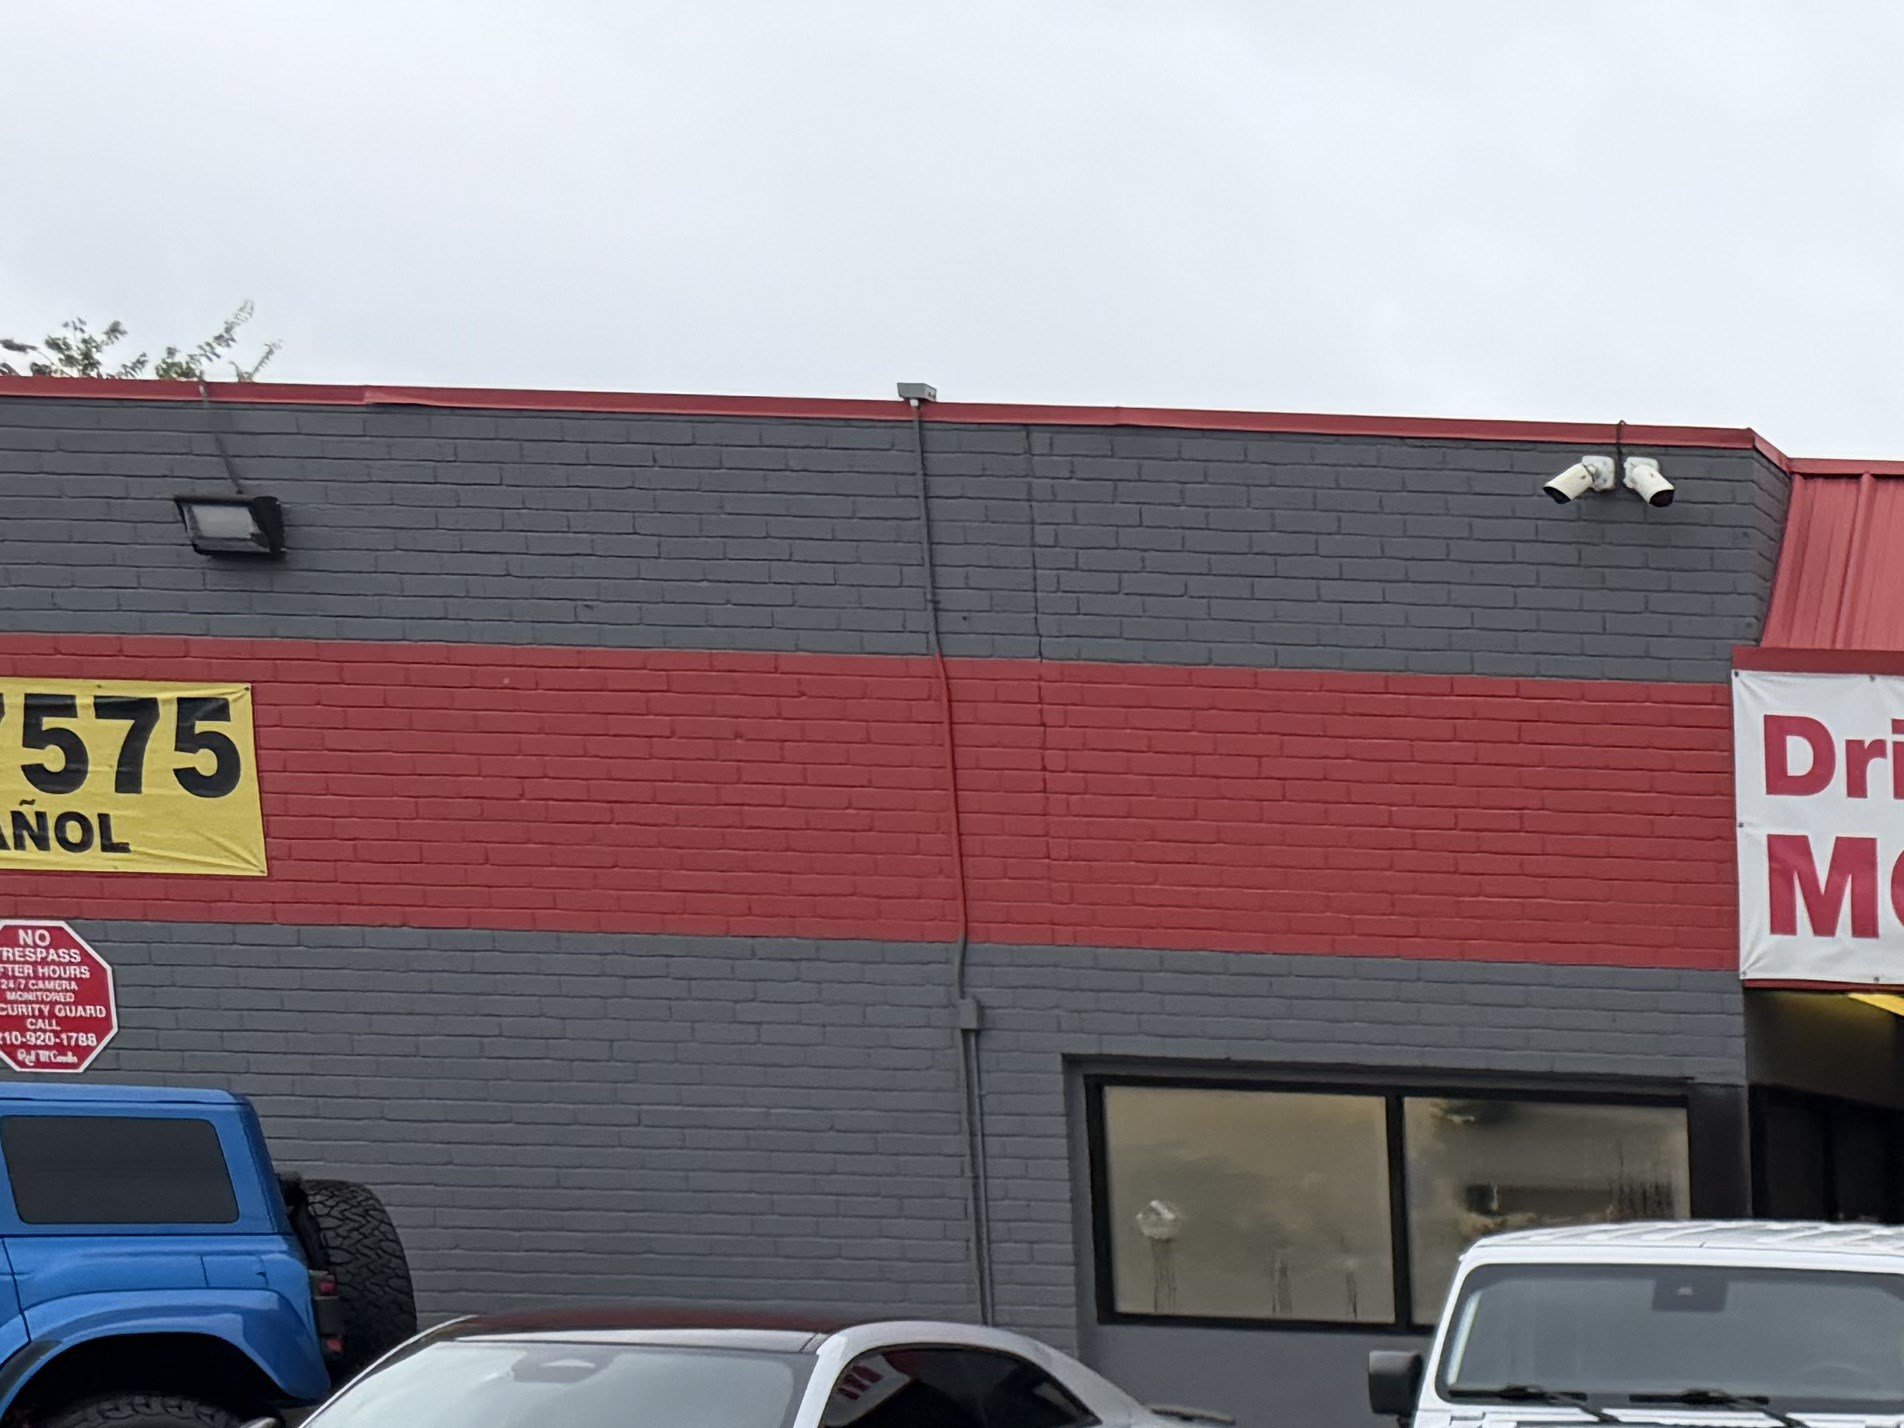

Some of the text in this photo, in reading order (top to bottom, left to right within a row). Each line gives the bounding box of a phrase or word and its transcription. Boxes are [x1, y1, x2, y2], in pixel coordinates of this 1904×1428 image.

[0, 692, 241, 799] 575
[18, 928, 51, 947] NO
[37, 964, 91, 979] HOURS
[29, 980, 78, 991] CAMERA
[55, 1005, 107, 1018] GUARD
[26, 1018, 61, 1031] CALL
